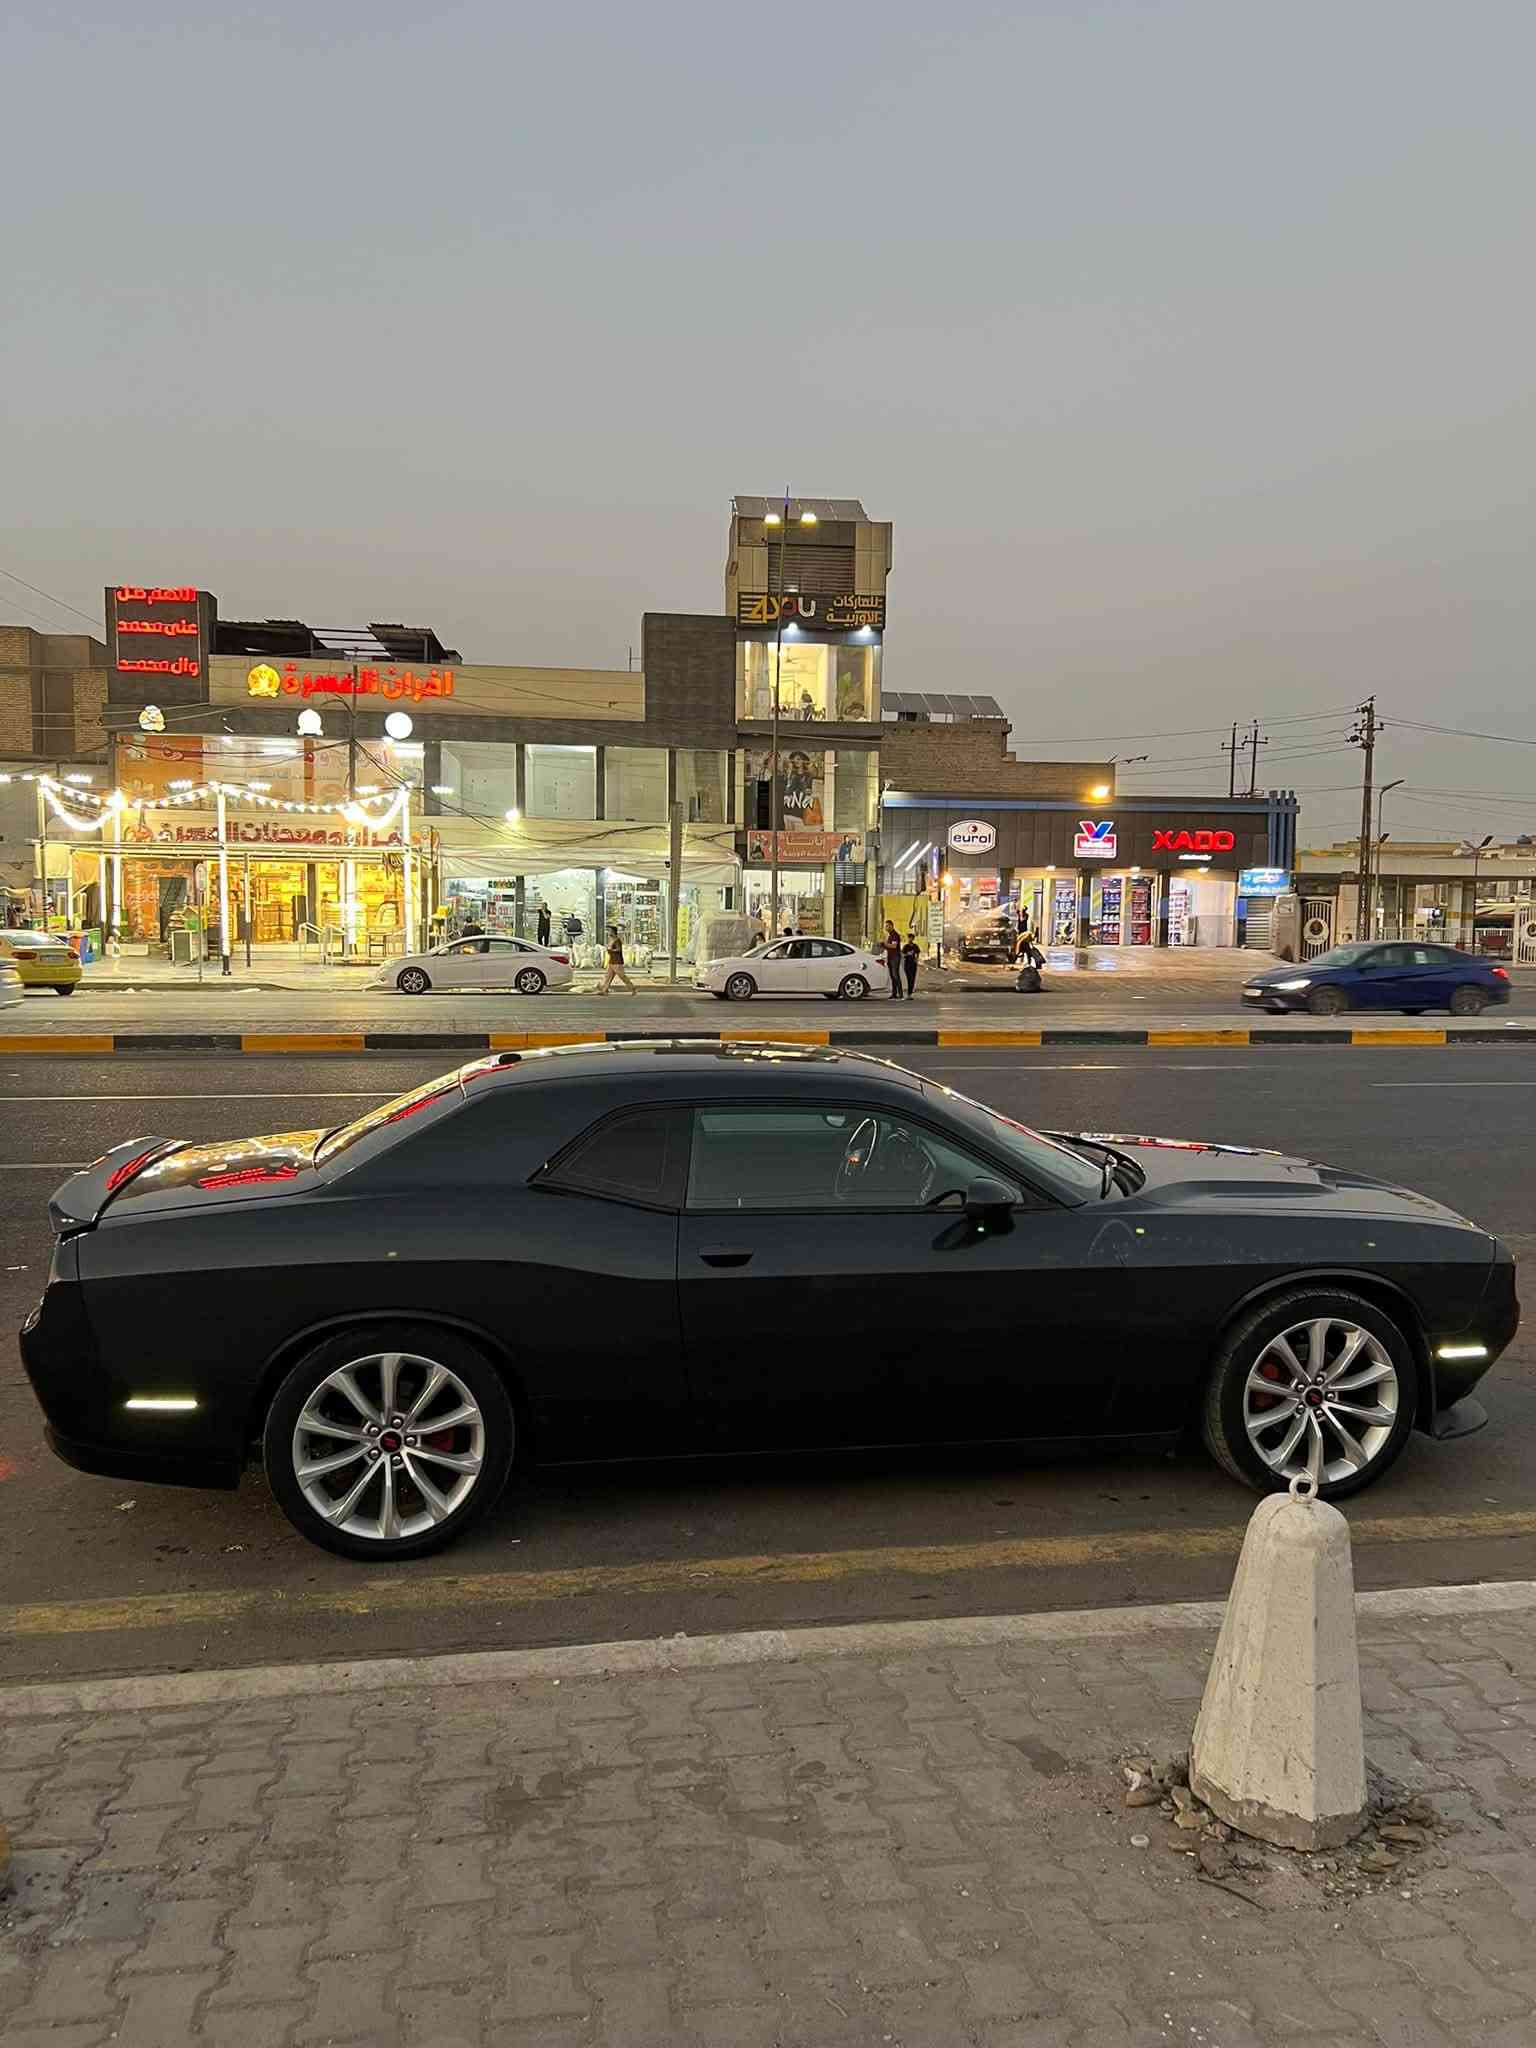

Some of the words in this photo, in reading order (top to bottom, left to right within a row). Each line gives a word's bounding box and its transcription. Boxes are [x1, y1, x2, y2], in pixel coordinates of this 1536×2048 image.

[117, 620, 163, 632] محمد
[117, 659, 168, 671] محمد
[953, 833, 992, 844] eurol
[1151, 830, 1235, 850] XADO
